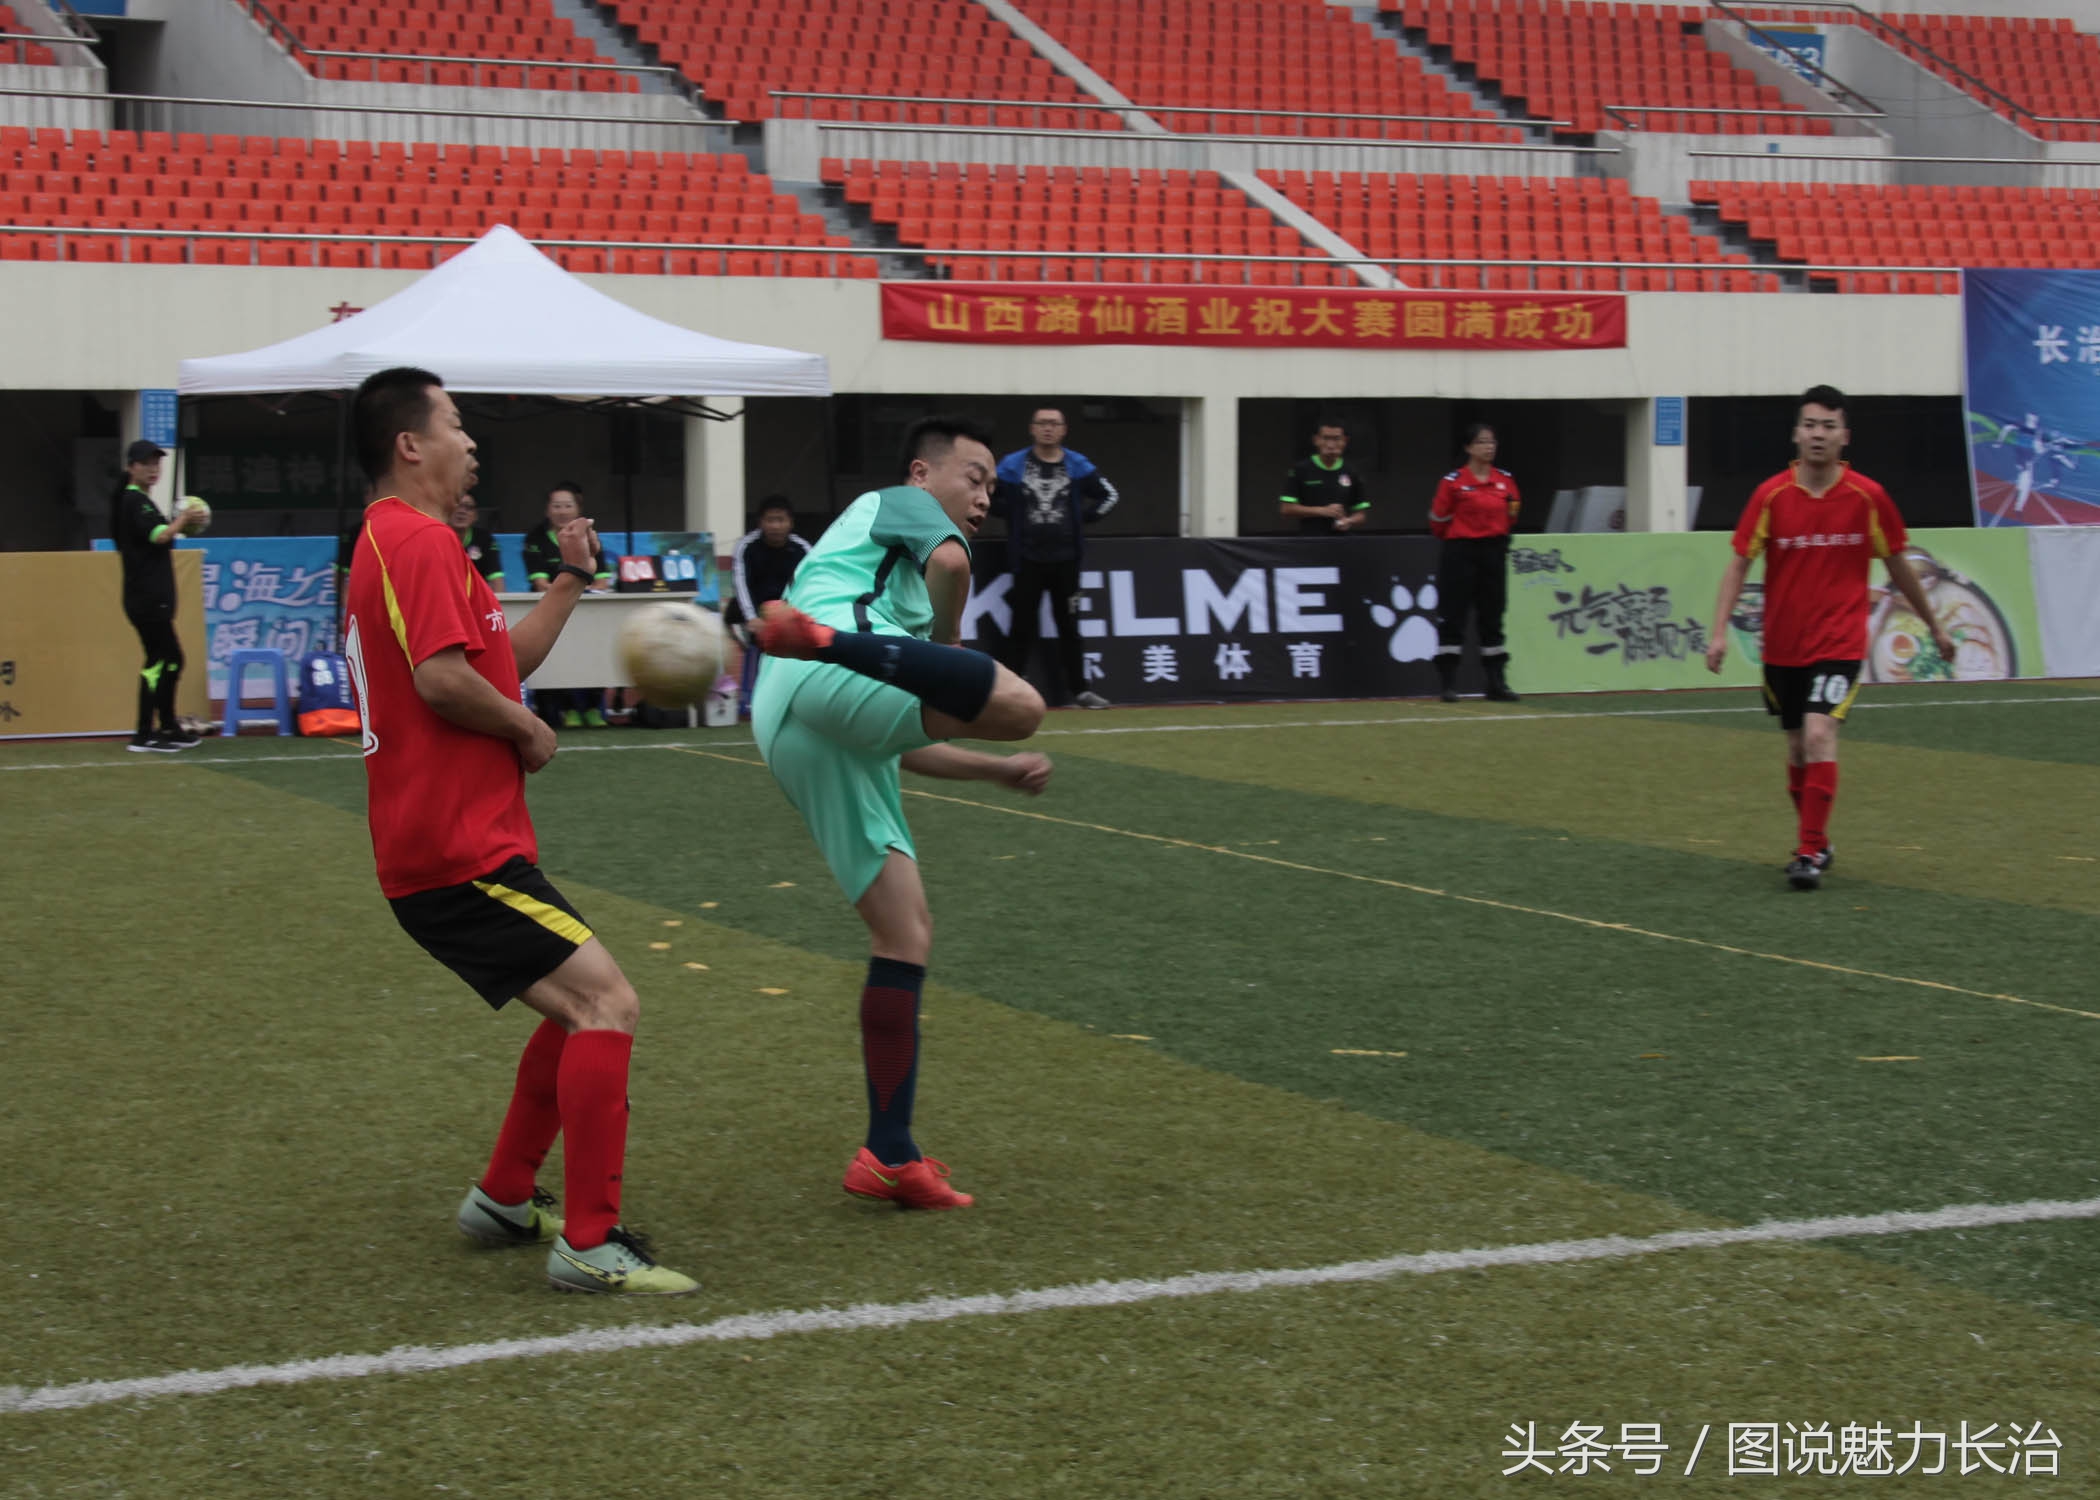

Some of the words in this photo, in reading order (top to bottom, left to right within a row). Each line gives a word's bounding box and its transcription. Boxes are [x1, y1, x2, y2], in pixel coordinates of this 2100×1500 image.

[926, 293, 1594, 340] 山西潞仙酒业祝大赛圆满成功
[960, 566, 1344, 641] KELME
[1808, 675, 1849, 704] 10
